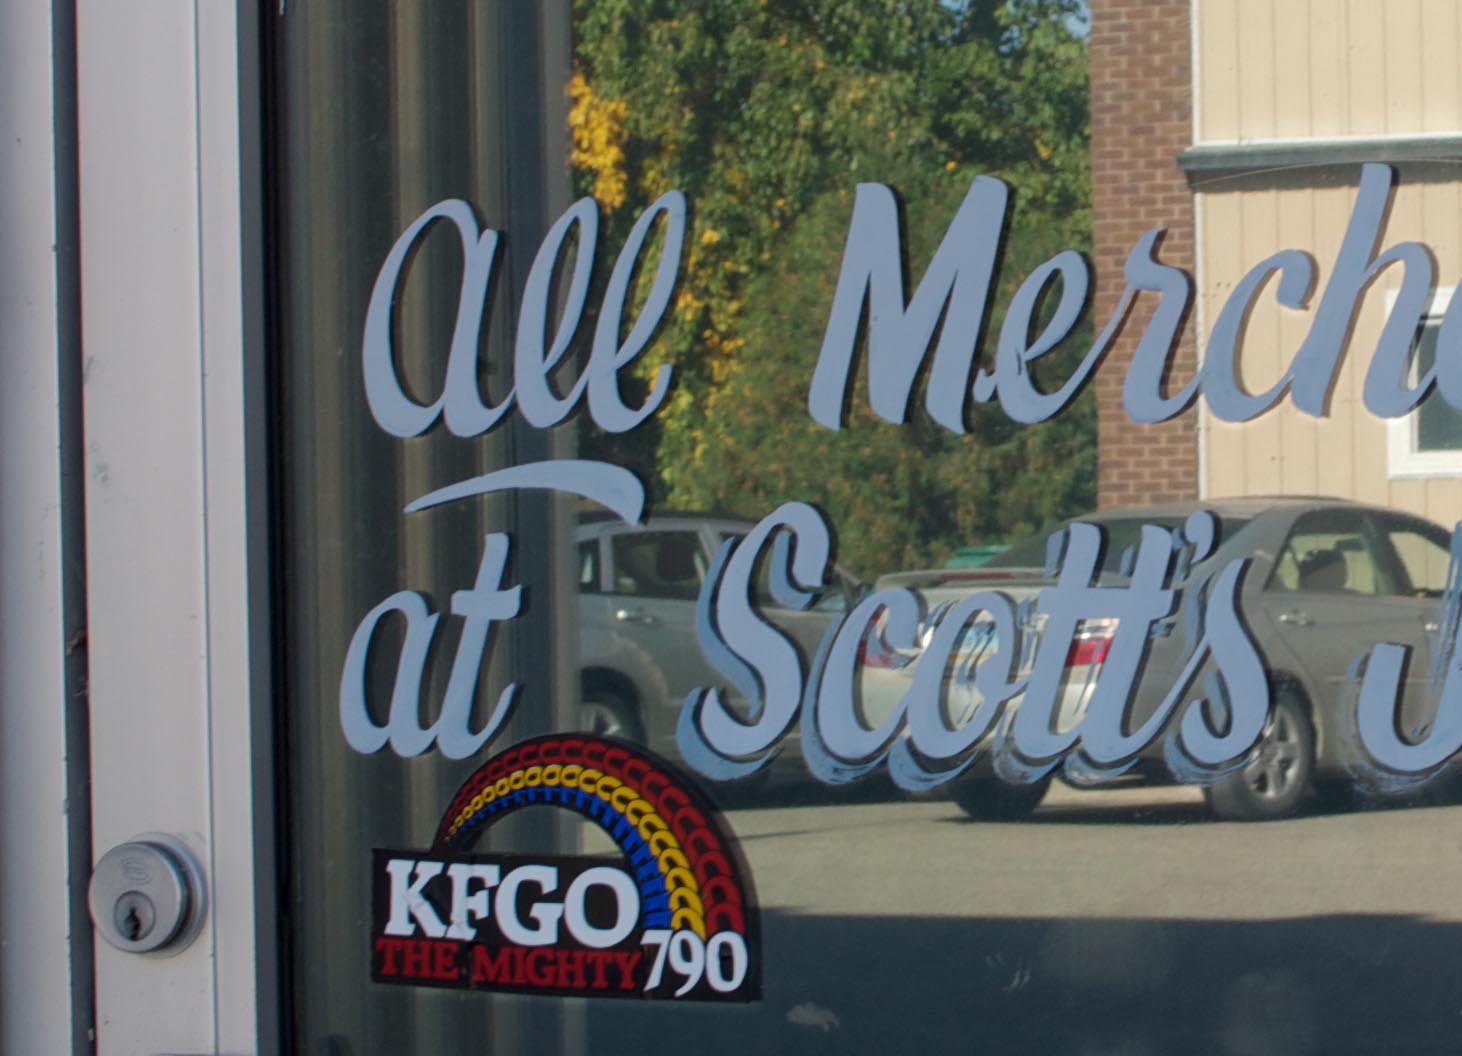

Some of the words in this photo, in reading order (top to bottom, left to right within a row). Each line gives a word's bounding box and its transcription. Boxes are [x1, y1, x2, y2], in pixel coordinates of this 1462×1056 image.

[339, 532, 524, 761] at
[677, 502, 1275, 790] Scott's
[384, 858, 641, 949] KFGO
[376, 939, 460, 982] THE
[472, 945, 642, 992] MIGHTY
[640, 929, 749, 999] 790
